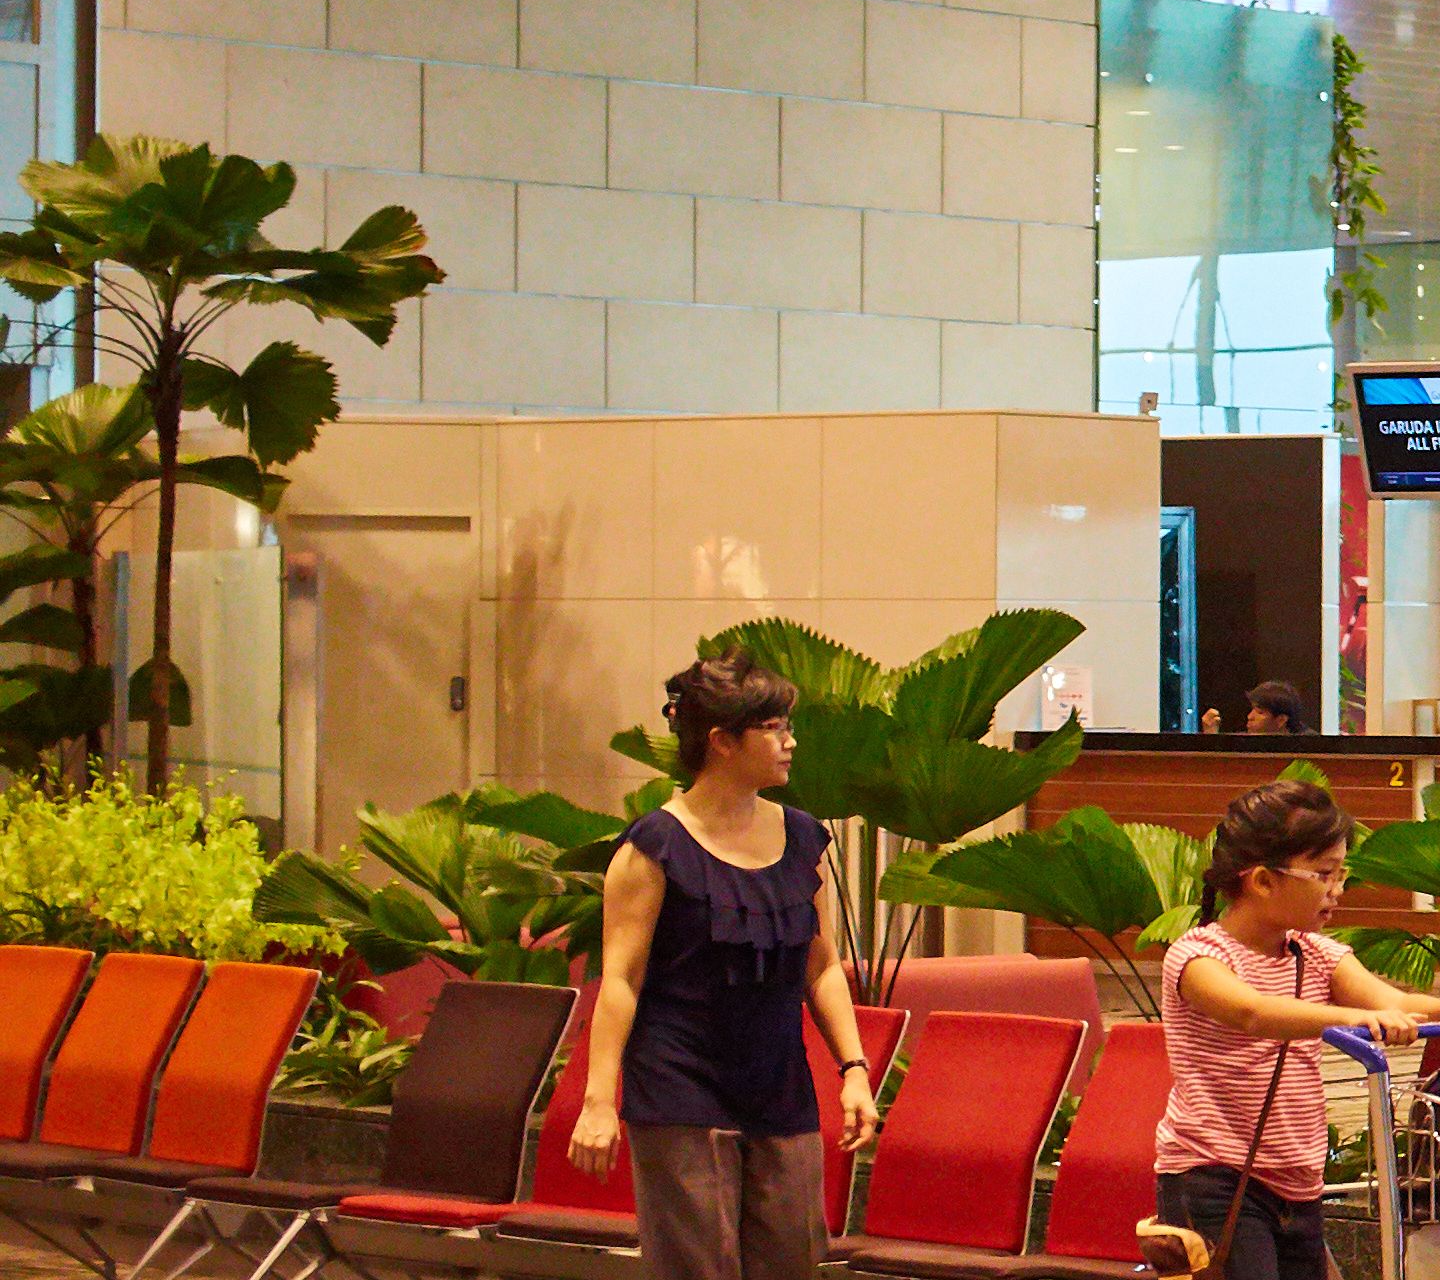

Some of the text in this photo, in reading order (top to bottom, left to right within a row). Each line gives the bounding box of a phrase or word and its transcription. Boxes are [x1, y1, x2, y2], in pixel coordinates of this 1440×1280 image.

[1379, 420, 1433, 435] GARUDA
[1407, 437, 1430, 451] ALL
[1389, 762, 1404, 787] 2
